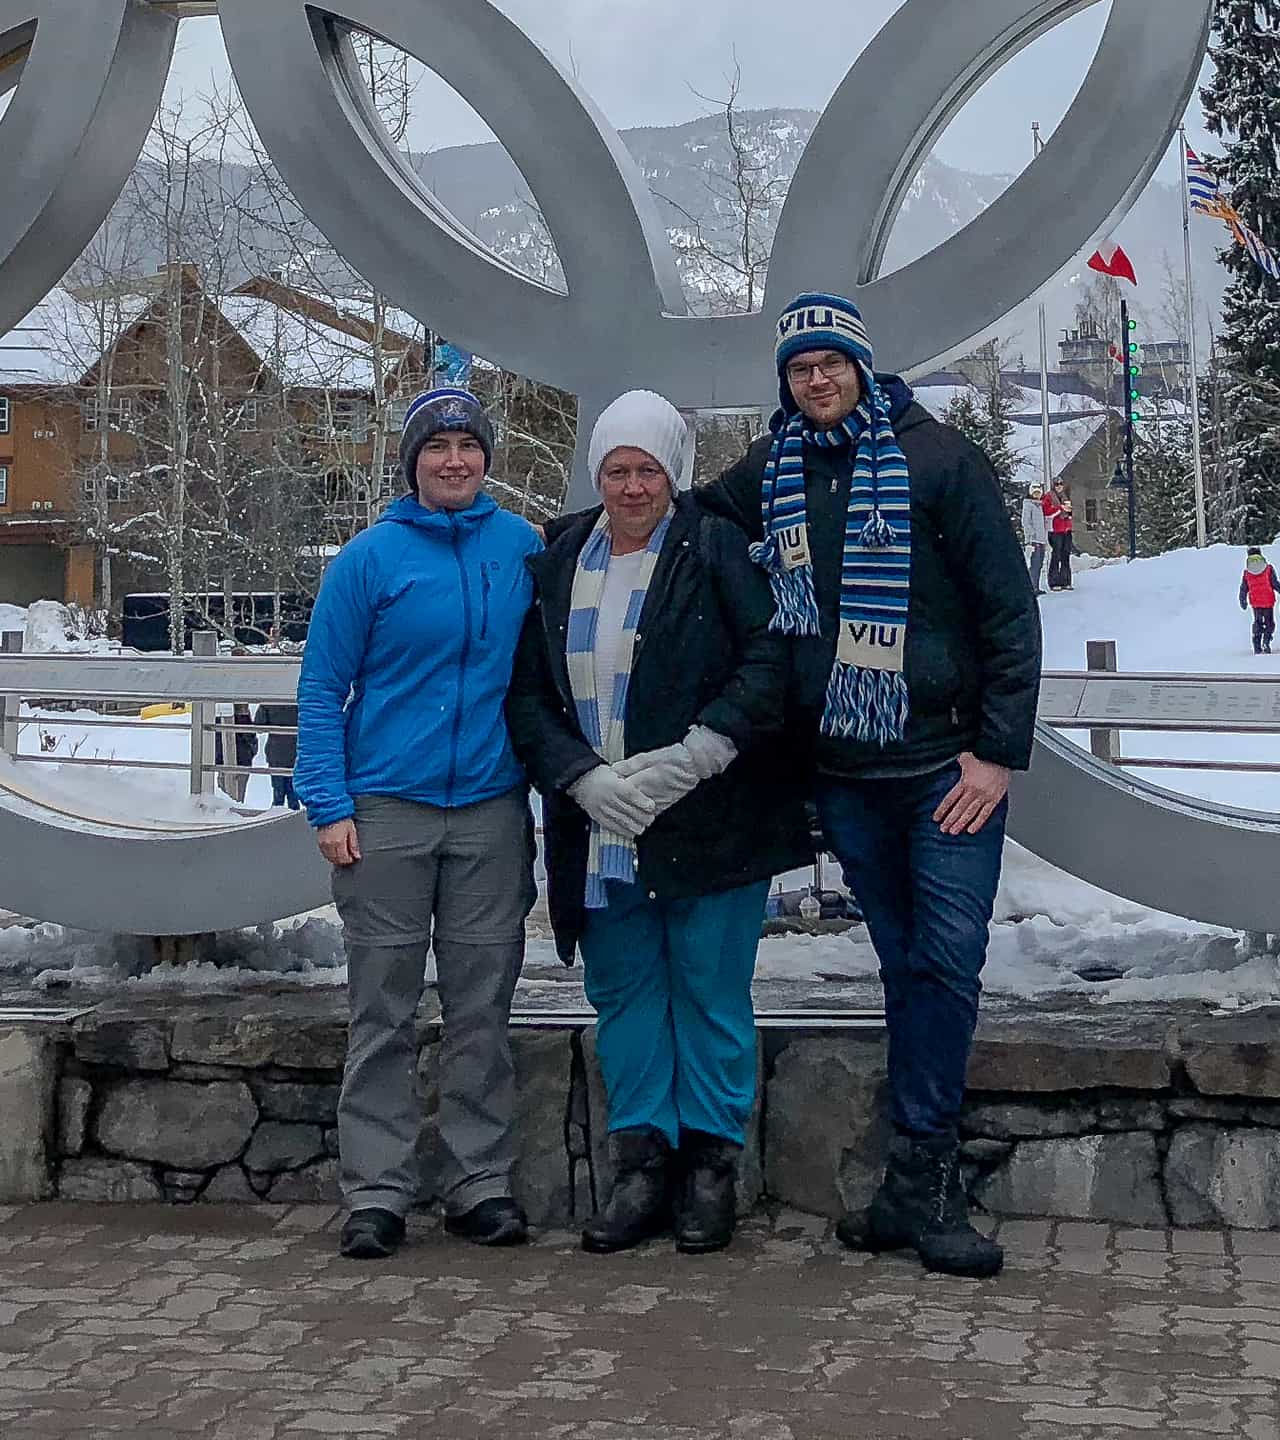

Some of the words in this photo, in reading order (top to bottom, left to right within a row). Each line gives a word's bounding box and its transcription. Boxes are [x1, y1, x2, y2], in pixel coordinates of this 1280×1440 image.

[779, 309, 833, 336] VIU
[778, 527, 801, 551] IU
[848, 622, 897, 647] VIU
